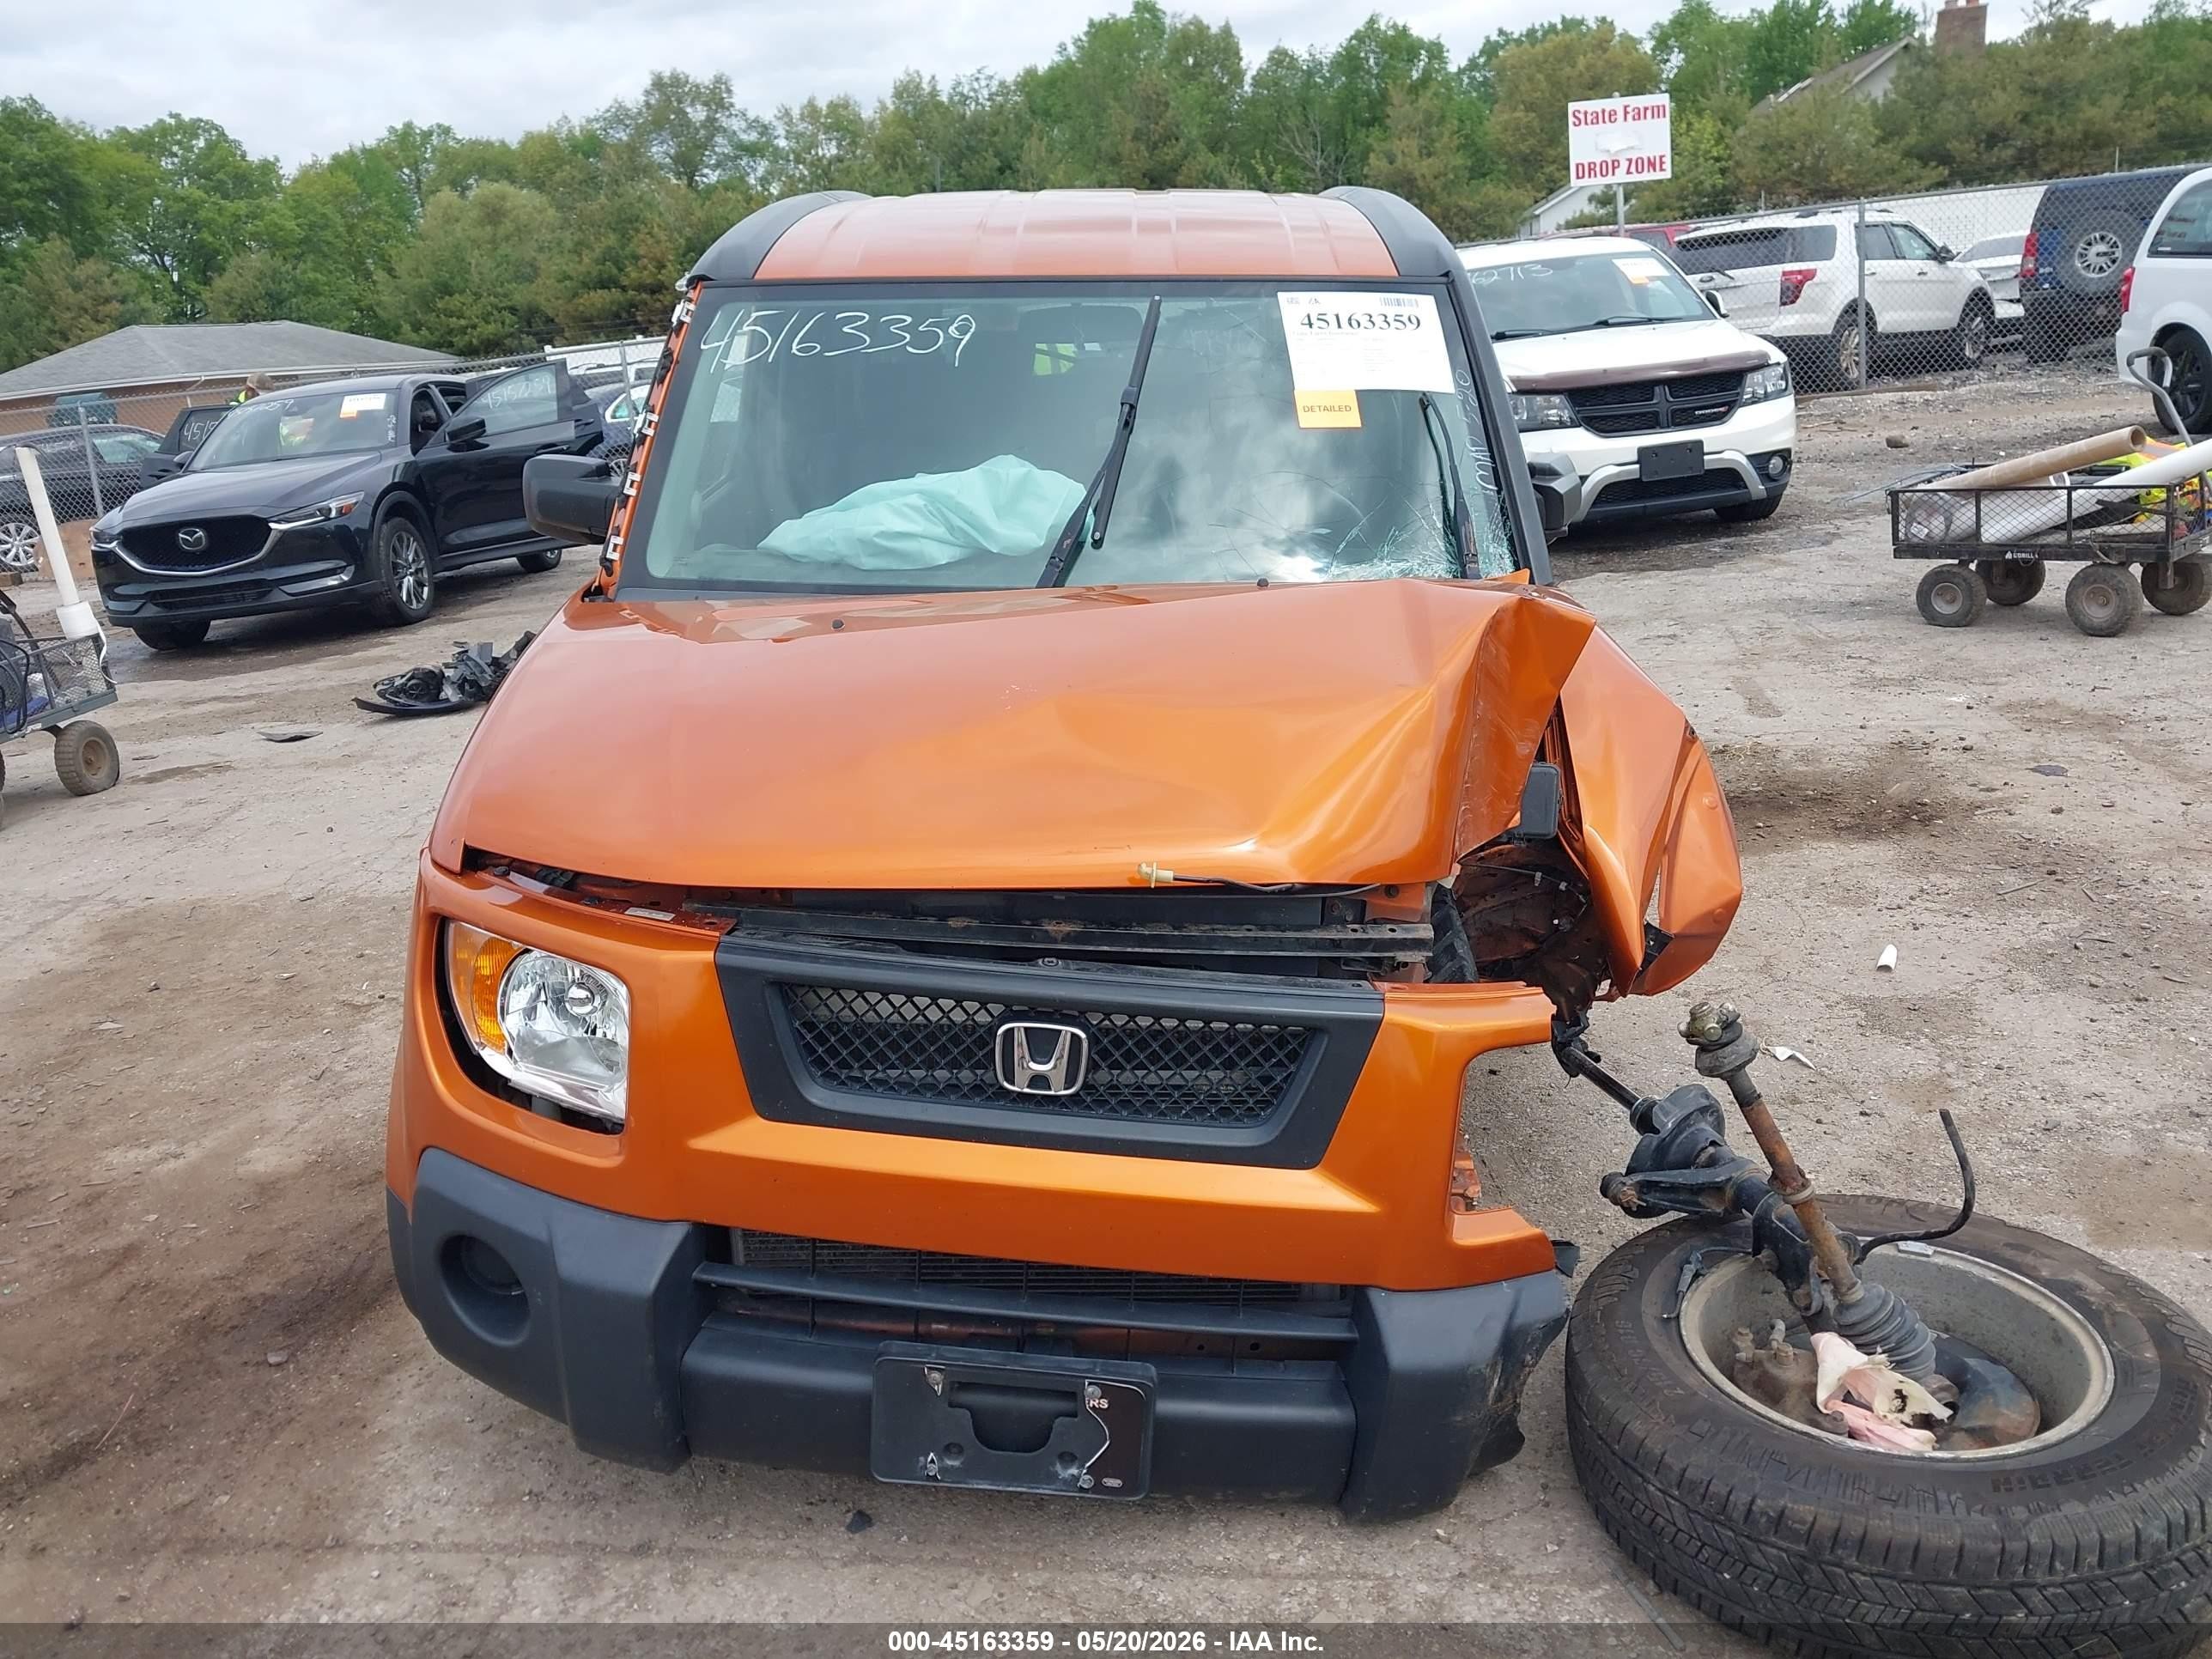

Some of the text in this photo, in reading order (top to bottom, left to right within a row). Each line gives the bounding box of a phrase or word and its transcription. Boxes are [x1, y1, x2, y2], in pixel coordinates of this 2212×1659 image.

[1571, 104, 1667, 127] State Farm
[1575, 155, 1667, 179] DROP ZONE
[1300, 312, 1421, 331] 45163359
[700, 308, 976, 374] 45163359
[1303, 404, 1352, 413] DETAILED
